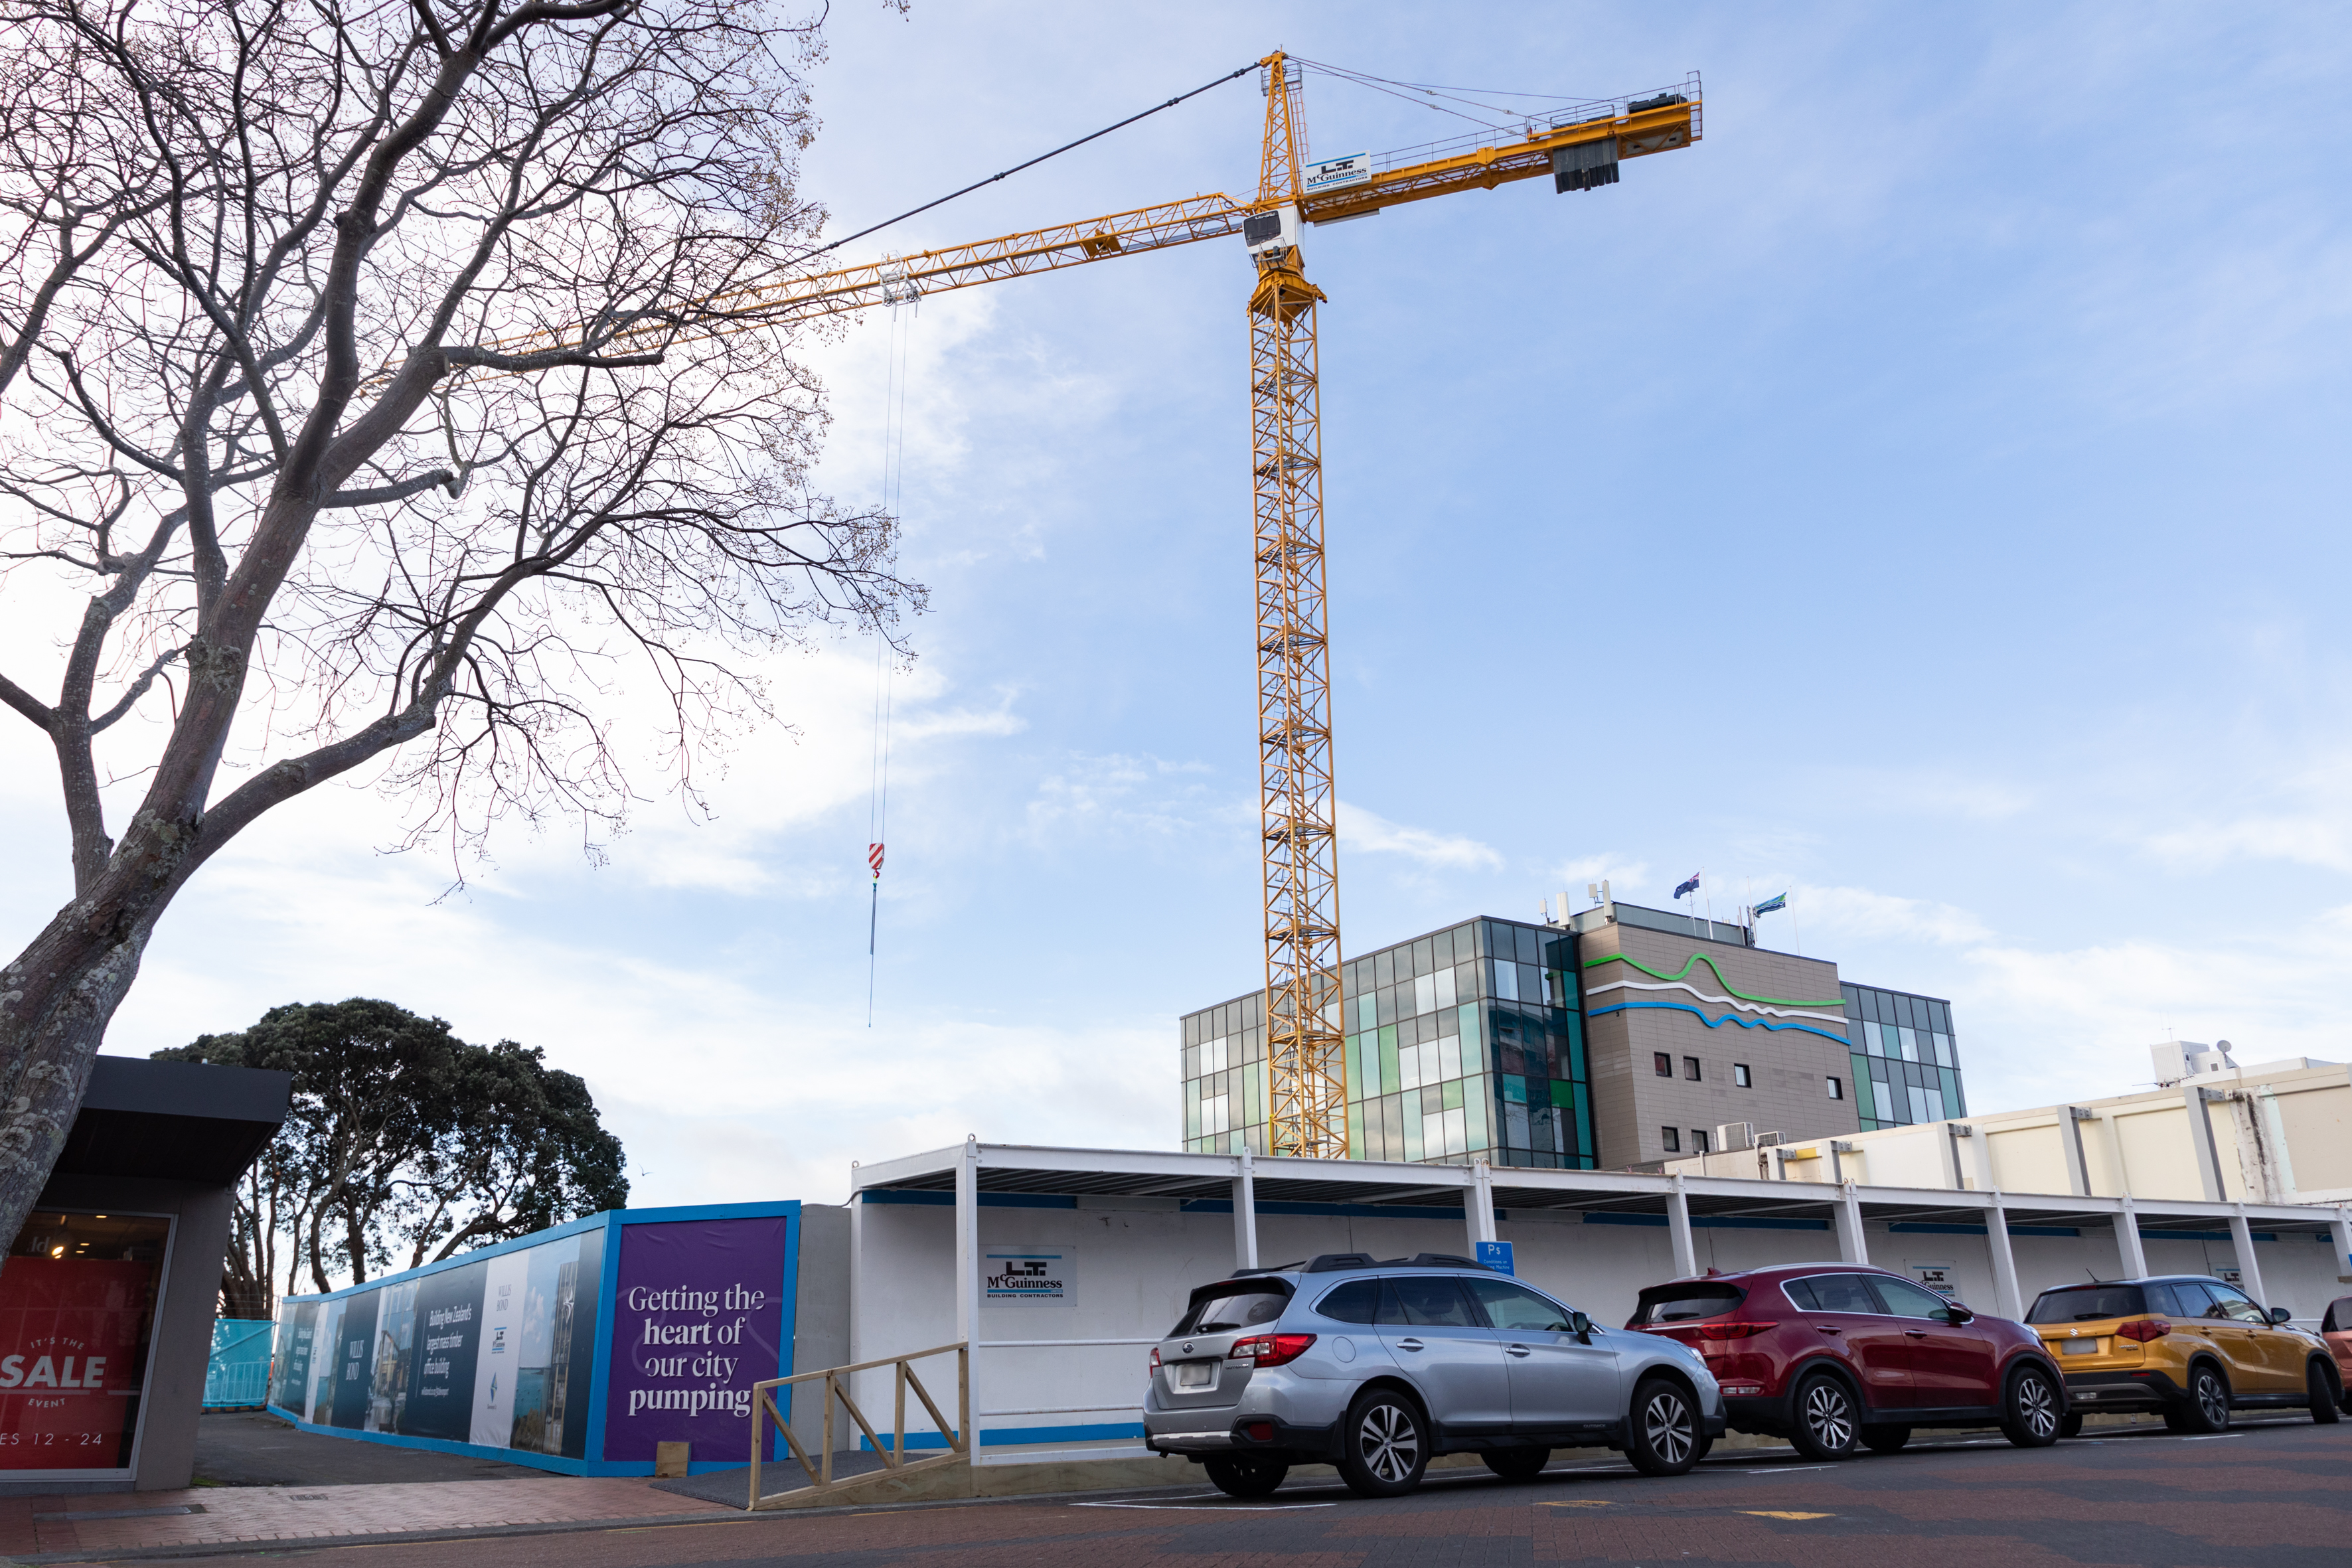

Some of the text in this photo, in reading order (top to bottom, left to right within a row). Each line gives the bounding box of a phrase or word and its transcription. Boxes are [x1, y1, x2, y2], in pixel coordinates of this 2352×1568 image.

[1307, 168, 1367, 185] McGuinness
[1332, 176, 1368, 186] CONTRACTORS
[499, 1284, 512, 1297] WILLIS
[987, 1274, 1062, 1289] McGuinness
[497, 1299, 509, 1312] BOND
[629, 1283, 765, 1317] Getting the
[430, 1309, 445, 1330] Building
[444, 1307, 453, 1324] New
[643, 1316, 745, 1345] heart of
[31, 1337, 84, 1350] IT'S THE
[427, 1330, 463, 1355] largest mass timber
[0, 1354, 107, 1387] SALE
[346, 1362, 360, 1380] BOND
[424, 1357, 450, 1379] office building
[645, 1350, 739, 1384] our city
[28, 1398, 66, 1408] EVENT
[627, 1382, 751, 1417] pumping
[35, 1433, 54, 1445] 12
[80, 1433, 102, 1445] 24
